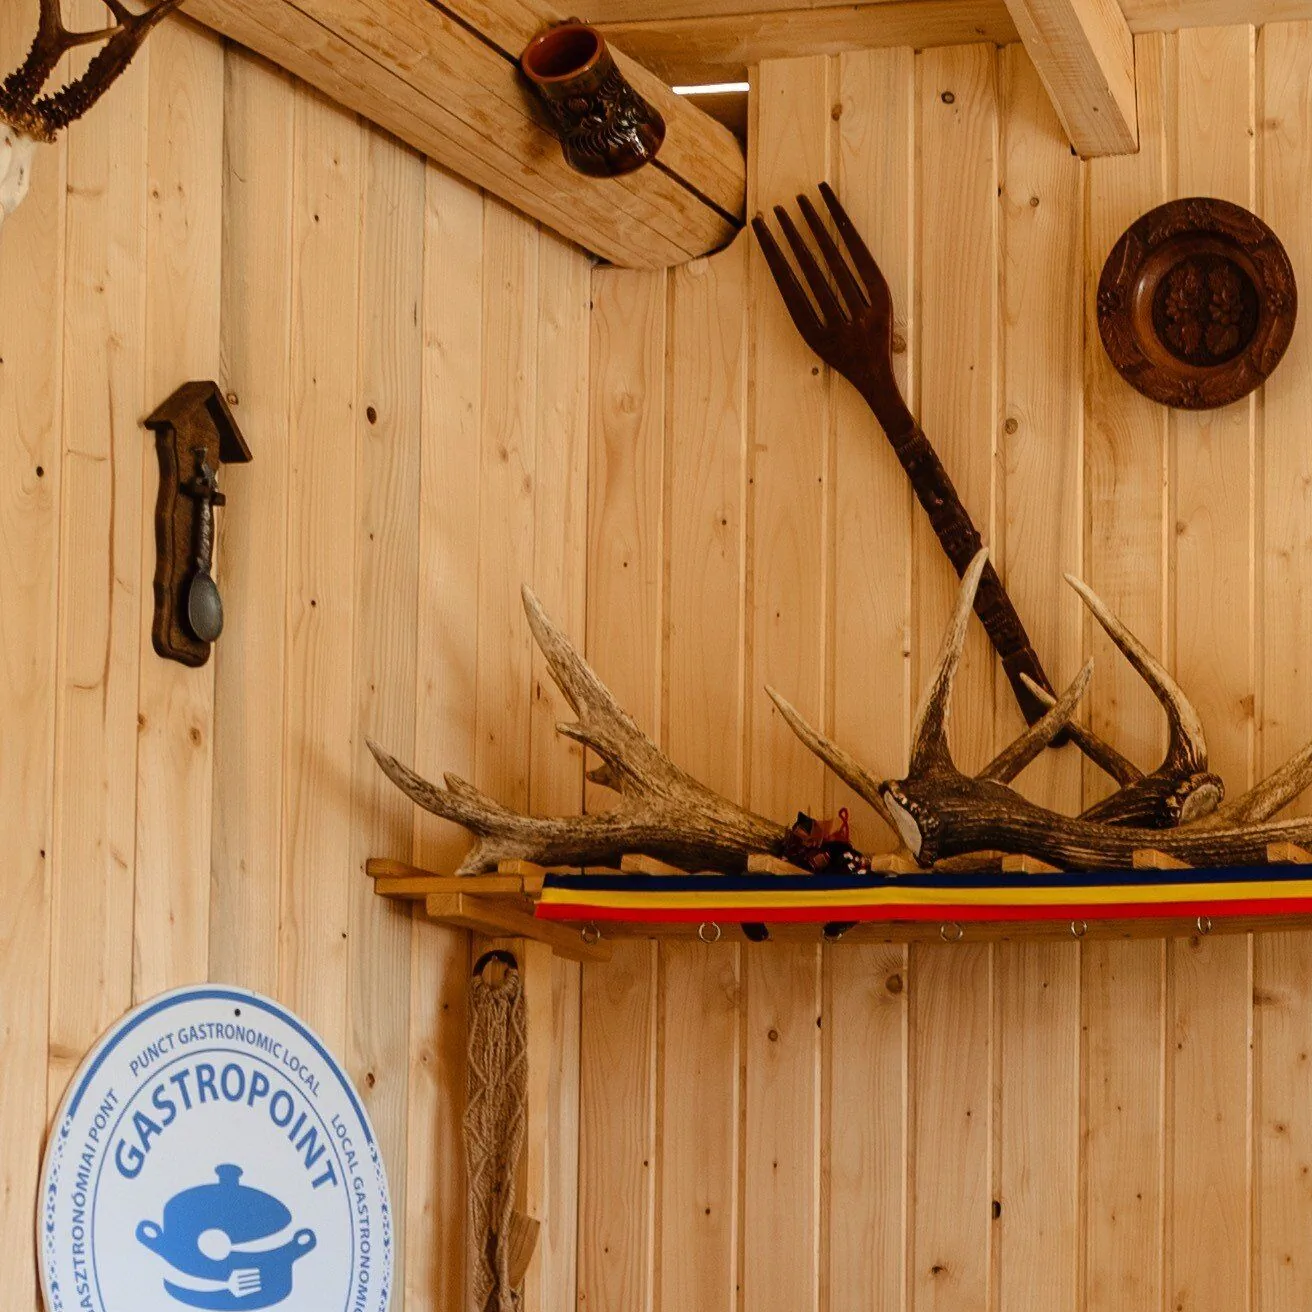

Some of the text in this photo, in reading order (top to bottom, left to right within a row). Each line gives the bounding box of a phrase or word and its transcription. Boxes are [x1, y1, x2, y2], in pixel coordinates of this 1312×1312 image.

[129, 1022, 321, 1097] PUNCT GASTRONOMIC LOCAL
[88, 1088, 119, 1143] PONT
[115, 1062, 339, 1190] GASTROPOINT
[331, 1113, 359, 1175] LOCAL
